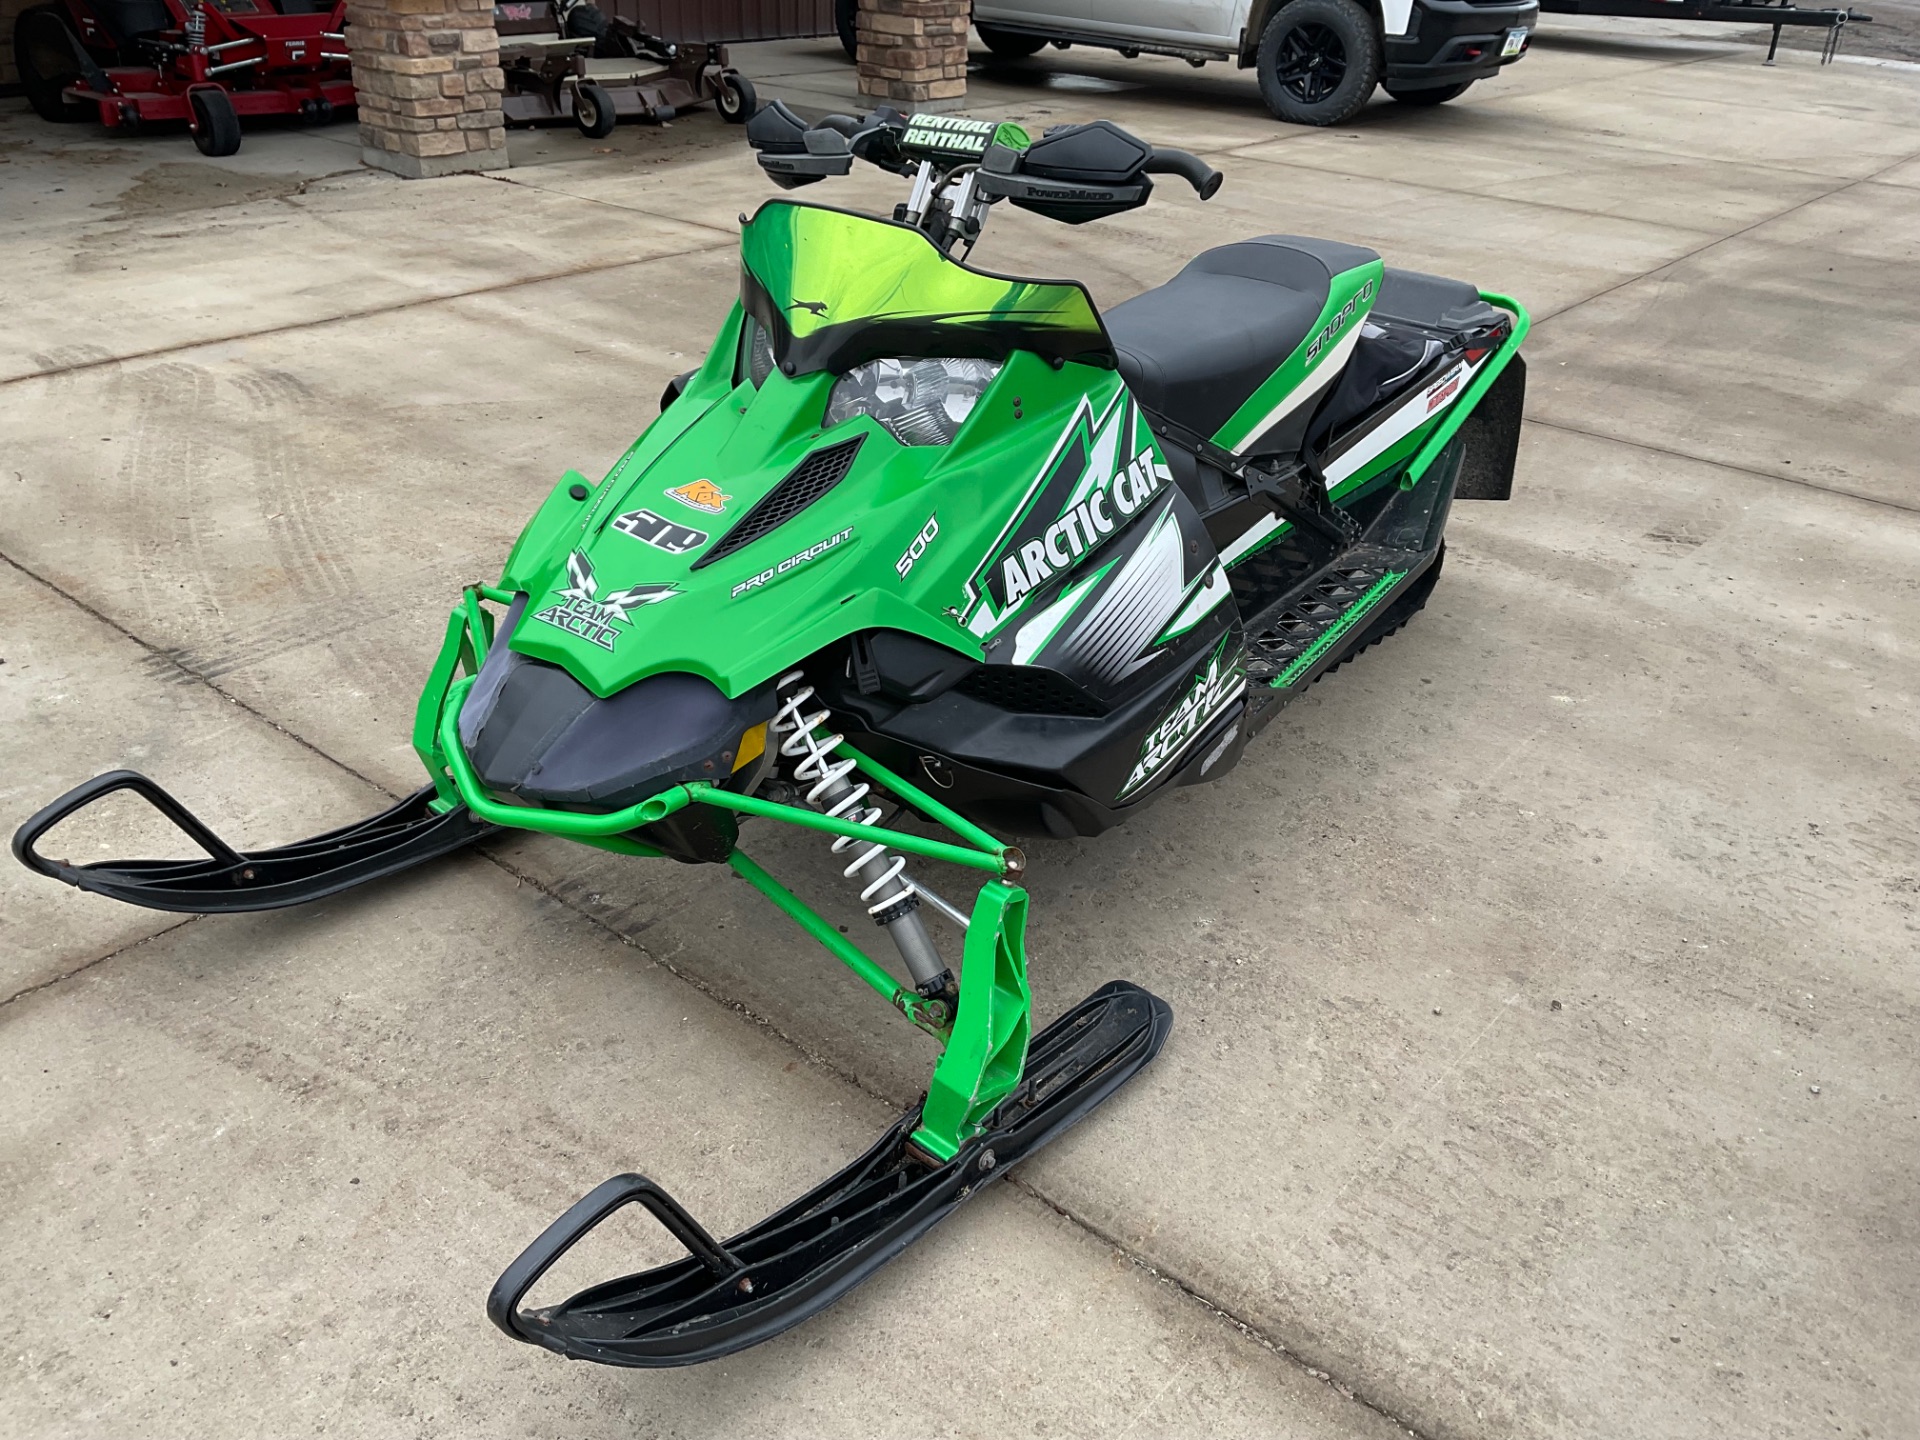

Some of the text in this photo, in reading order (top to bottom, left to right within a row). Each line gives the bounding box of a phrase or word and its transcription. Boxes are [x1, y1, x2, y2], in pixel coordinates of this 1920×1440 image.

[902, 128, 986, 152] RENTHAL
[908, 113, 995, 134] RENTHAL
[894, 511, 940, 581] 500
[1001, 446, 1159, 608] ARCTIC CAT
[731, 526, 854, 598] PRO CIRCUIT
[537, 606, 618, 649] ARCTIC
[564, 593, 616, 626] TEAM
[1144, 657, 1219, 749] TEAM
